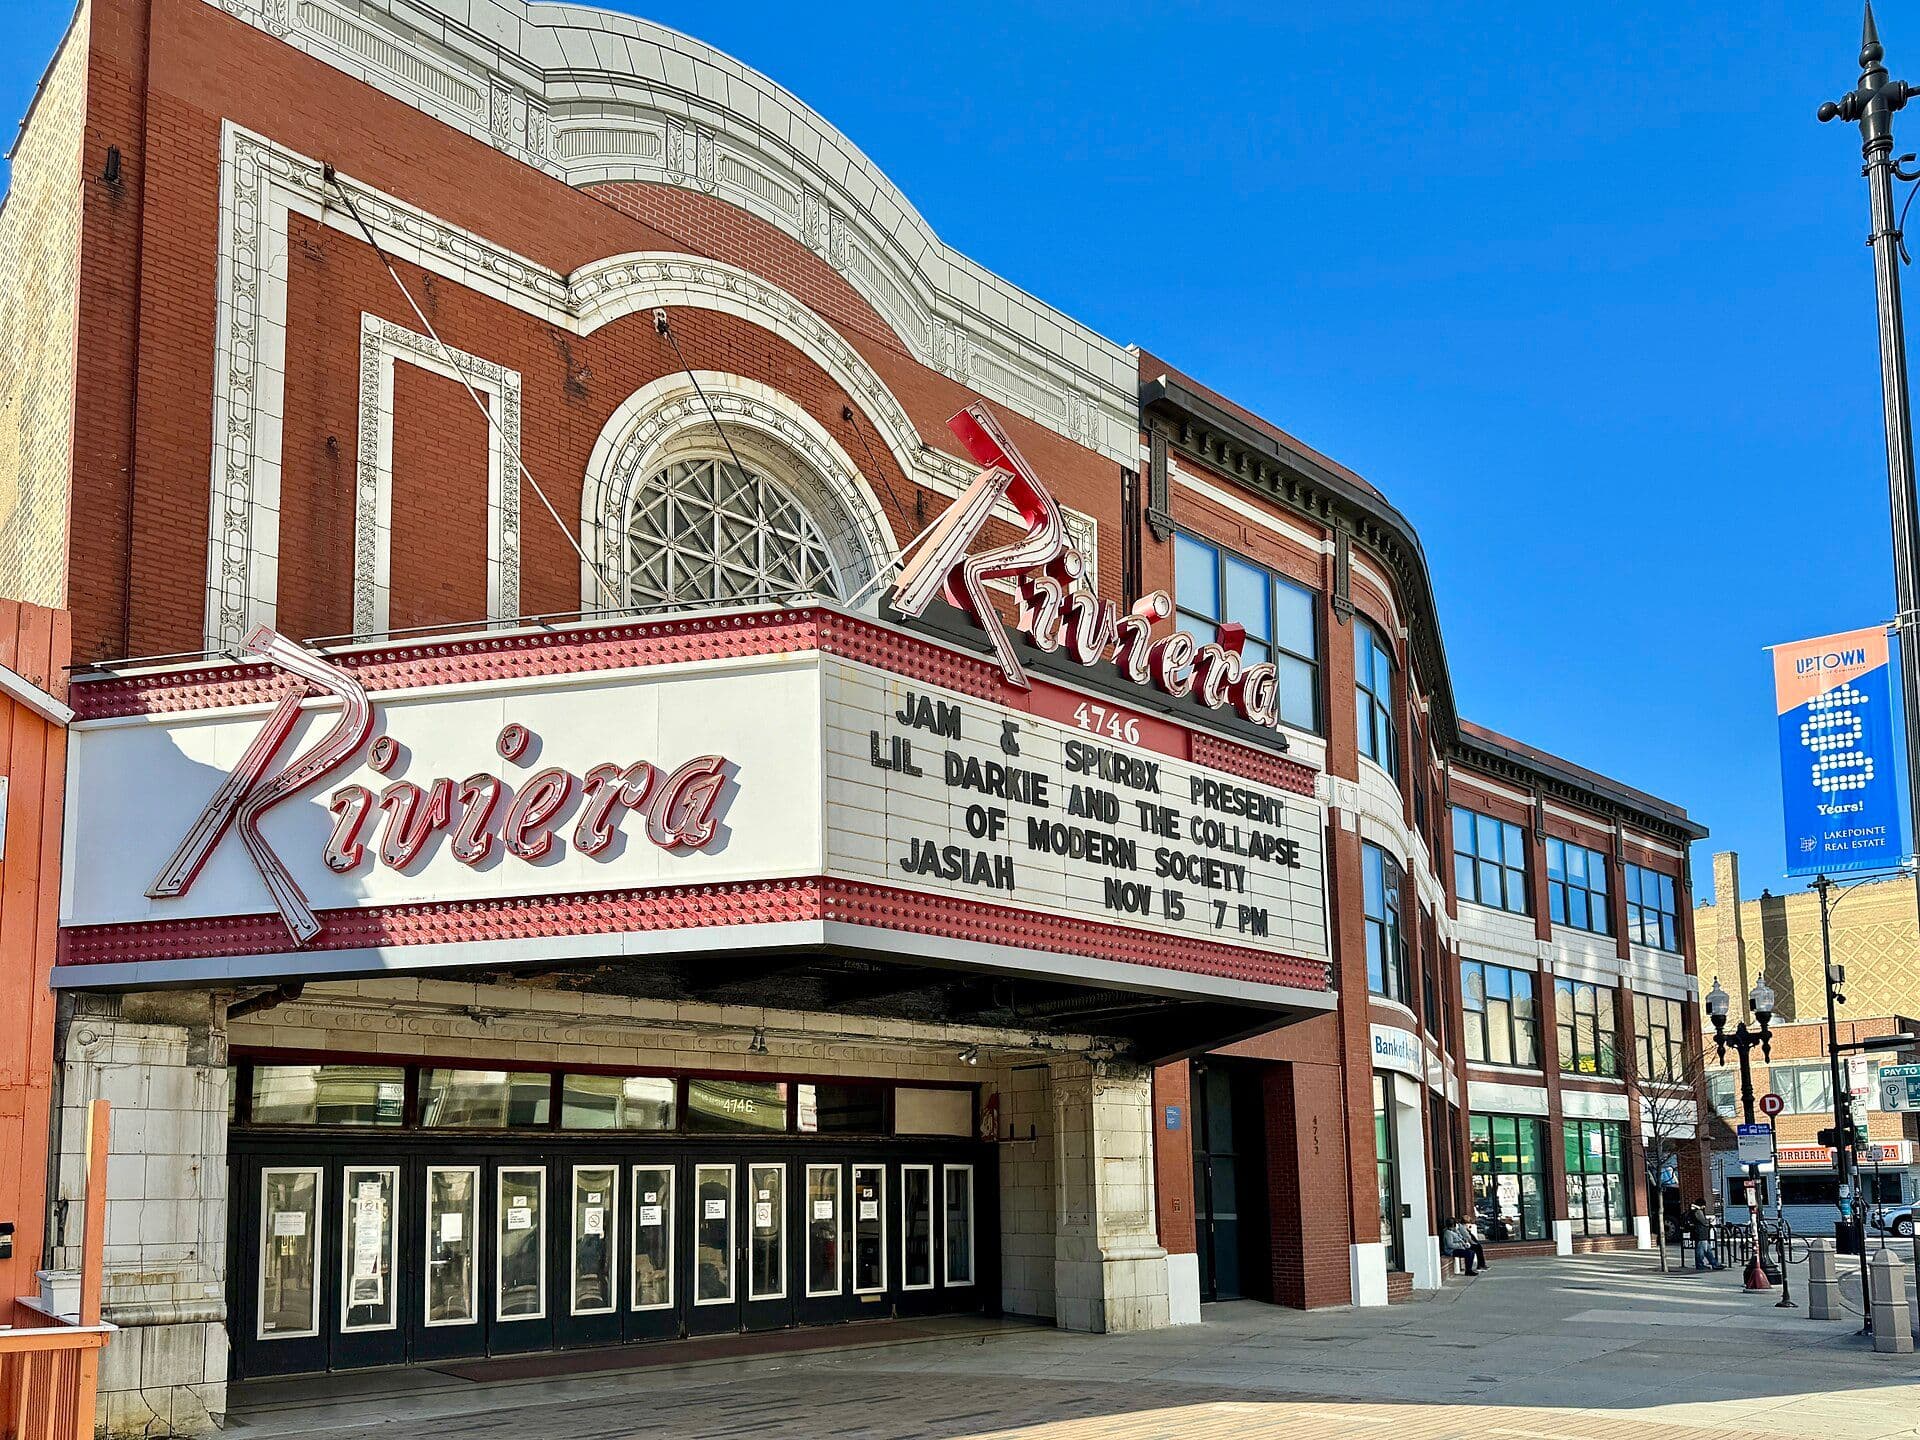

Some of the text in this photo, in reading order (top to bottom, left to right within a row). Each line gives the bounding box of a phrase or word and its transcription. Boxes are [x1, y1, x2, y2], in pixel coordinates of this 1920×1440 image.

[889, 400, 1279, 727] Riviera
[1796, 648, 1865, 674] UPTOWN
[1072, 701, 1140, 746] 4746
[896, 691, 1284, 827] JAM & SPKRBX PRESENT
[145, 623, 727, 946] Riviera
[871, 730, 1300, 868] LIL DARKIE AND THE COLLAPSE
[1816, 800, 1863, 816] Years!
[1824, 826, 1886, 840] LAKEPOINTE
[965, 804, 1245, 894] OF MODERN SOCIETY
[1825, 842, 1848, 852] REAL
[1852, 838, 1886, 849] ESTATE
[900, 837, 1268, 938] JASIAH NOV 15 7 PM
[1375, 1036, 1397, 1056] Bank
[1884, 1066, 1918, 1076] PAY TO
[723, 1099, 753, 1113] 4746
[1765, 1098, 1780, 1112] D
[1778, 1150, 1826, 1160] BIRRIERIA
